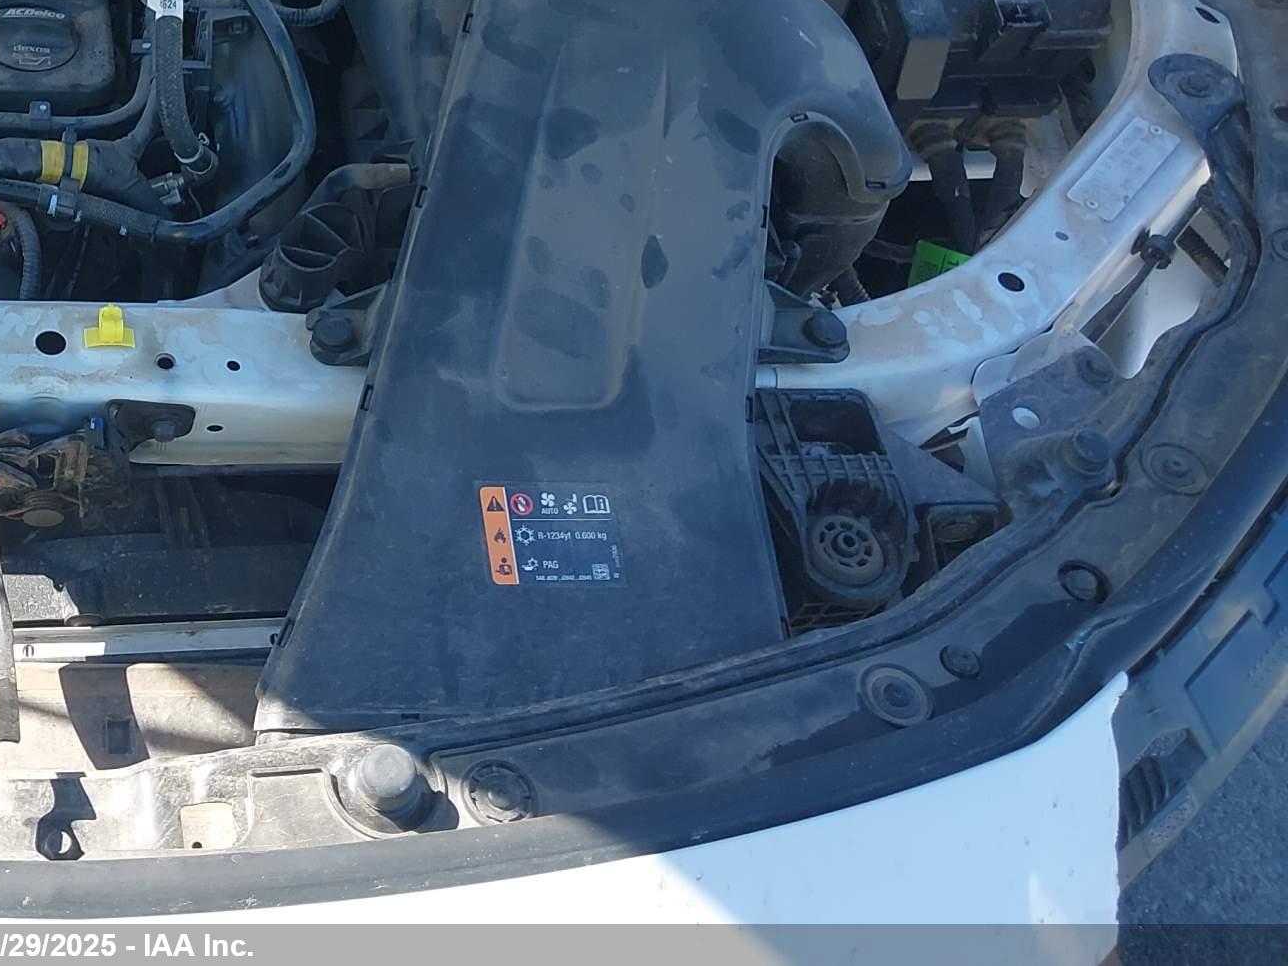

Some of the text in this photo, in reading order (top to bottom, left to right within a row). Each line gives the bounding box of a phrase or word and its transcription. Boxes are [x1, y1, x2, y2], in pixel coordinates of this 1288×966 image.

[2, 7, 65, 19] ACDelco
[575, 532, 596, 540] 0.600
[597, 532, 607, 541] kg
[542, 560, 559, 569] PAG
